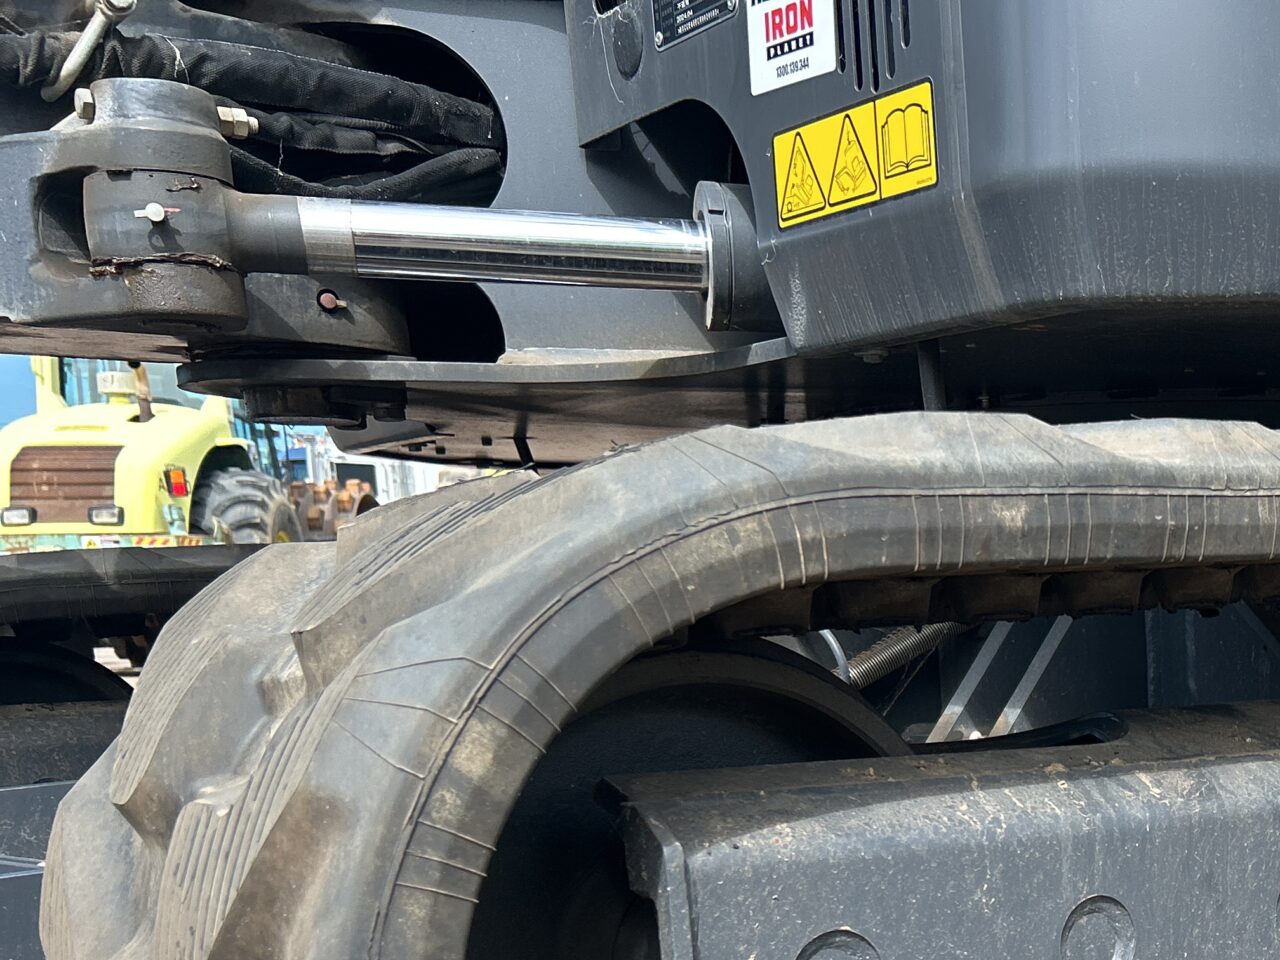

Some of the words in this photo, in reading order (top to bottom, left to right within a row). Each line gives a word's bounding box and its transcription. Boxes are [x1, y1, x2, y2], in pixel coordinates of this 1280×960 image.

[764, 0, 814, 43] IRON
[769, 34, 811, 58] PLANET
[776, 56, 810, 78] 1300.139.344
